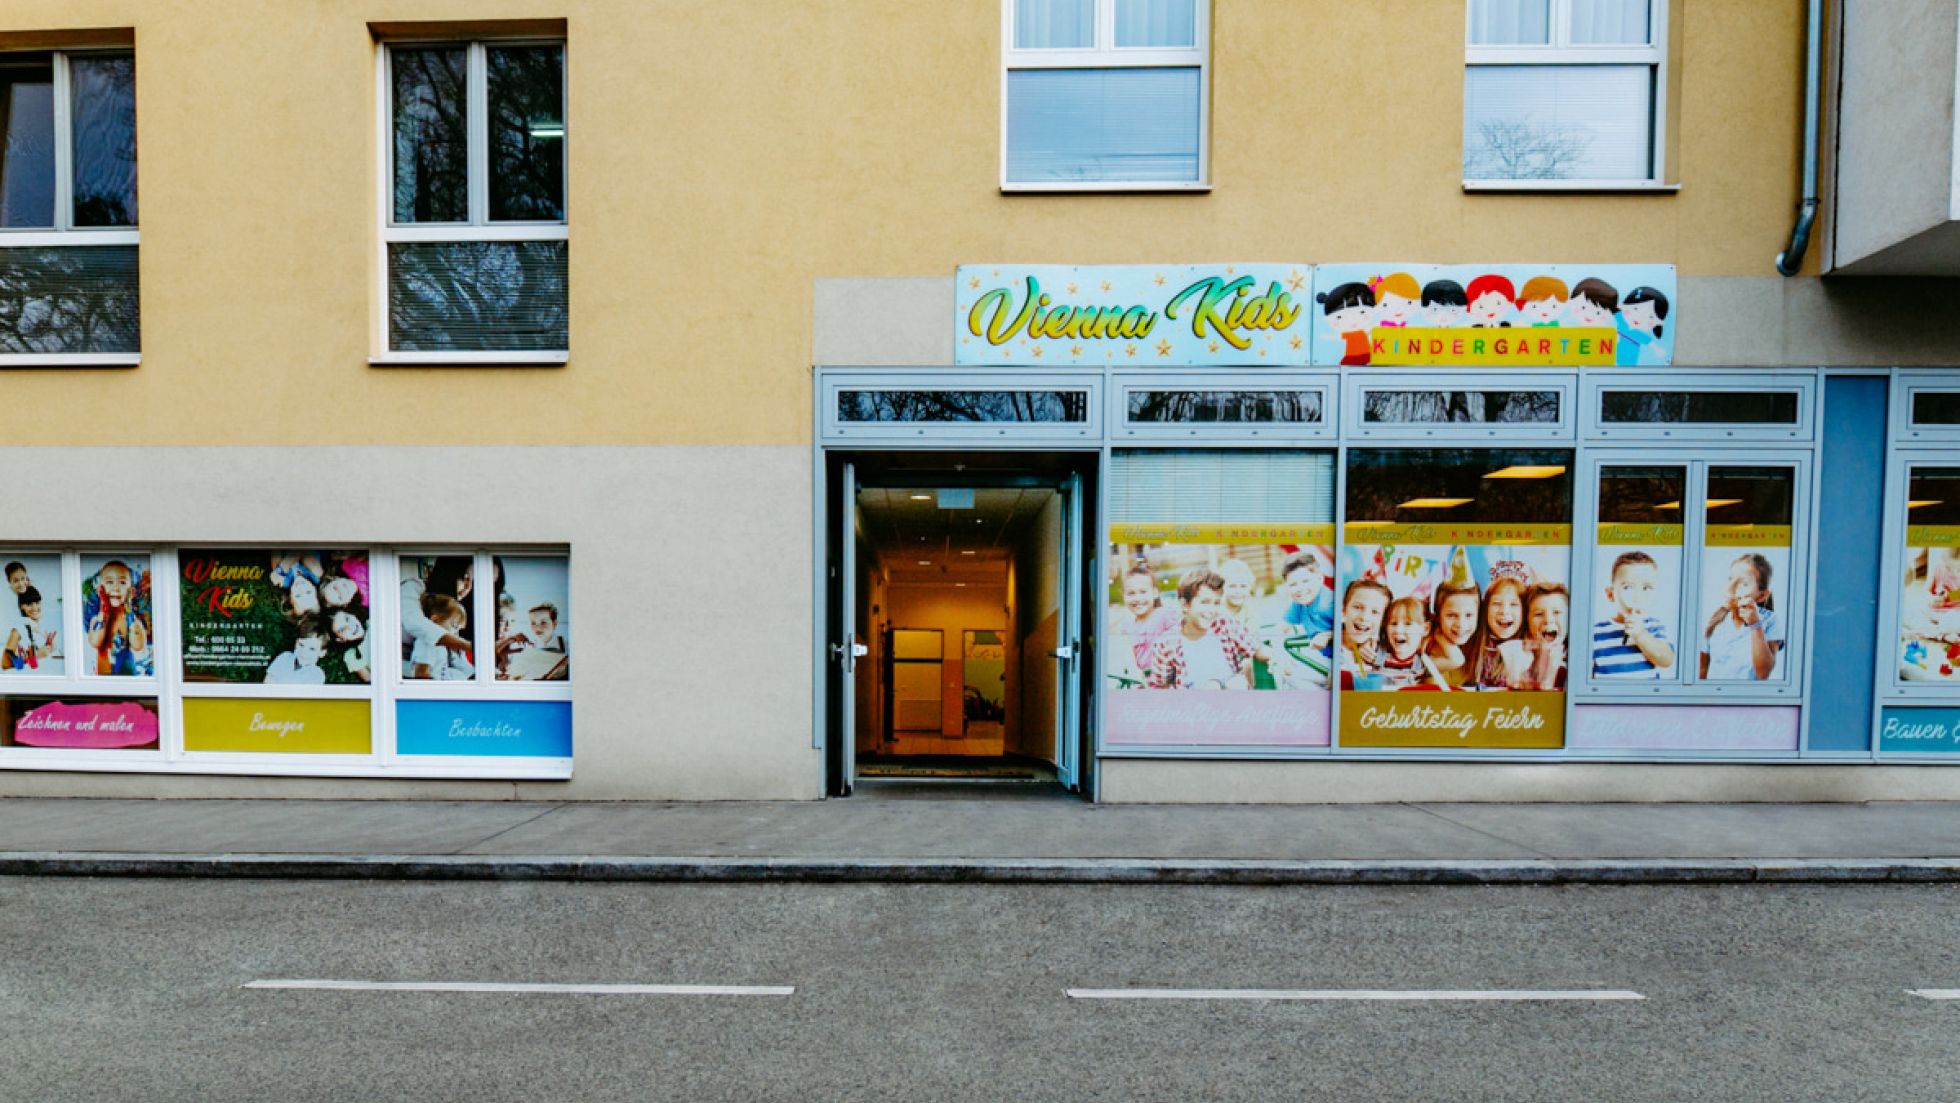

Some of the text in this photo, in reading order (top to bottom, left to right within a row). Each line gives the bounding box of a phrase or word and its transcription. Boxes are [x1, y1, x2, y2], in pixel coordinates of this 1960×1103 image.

[968, 275, 1301, 350] Vienna Kids
[1373, 338, 1613, 356] KINDERGARTEN
[184, 559, 264, 583] Vienna
[197, 585, 254, 618] Kids
[17, 711, 135, 733] Zeichnen und malen
[249, 712, 304, 737] Bewegen
[448, 718, 522, 737] Beobachten
[1360, 704, 1545, 738] Geburtstag Feiern
[1883, 717, 1947, 739] Bauen
